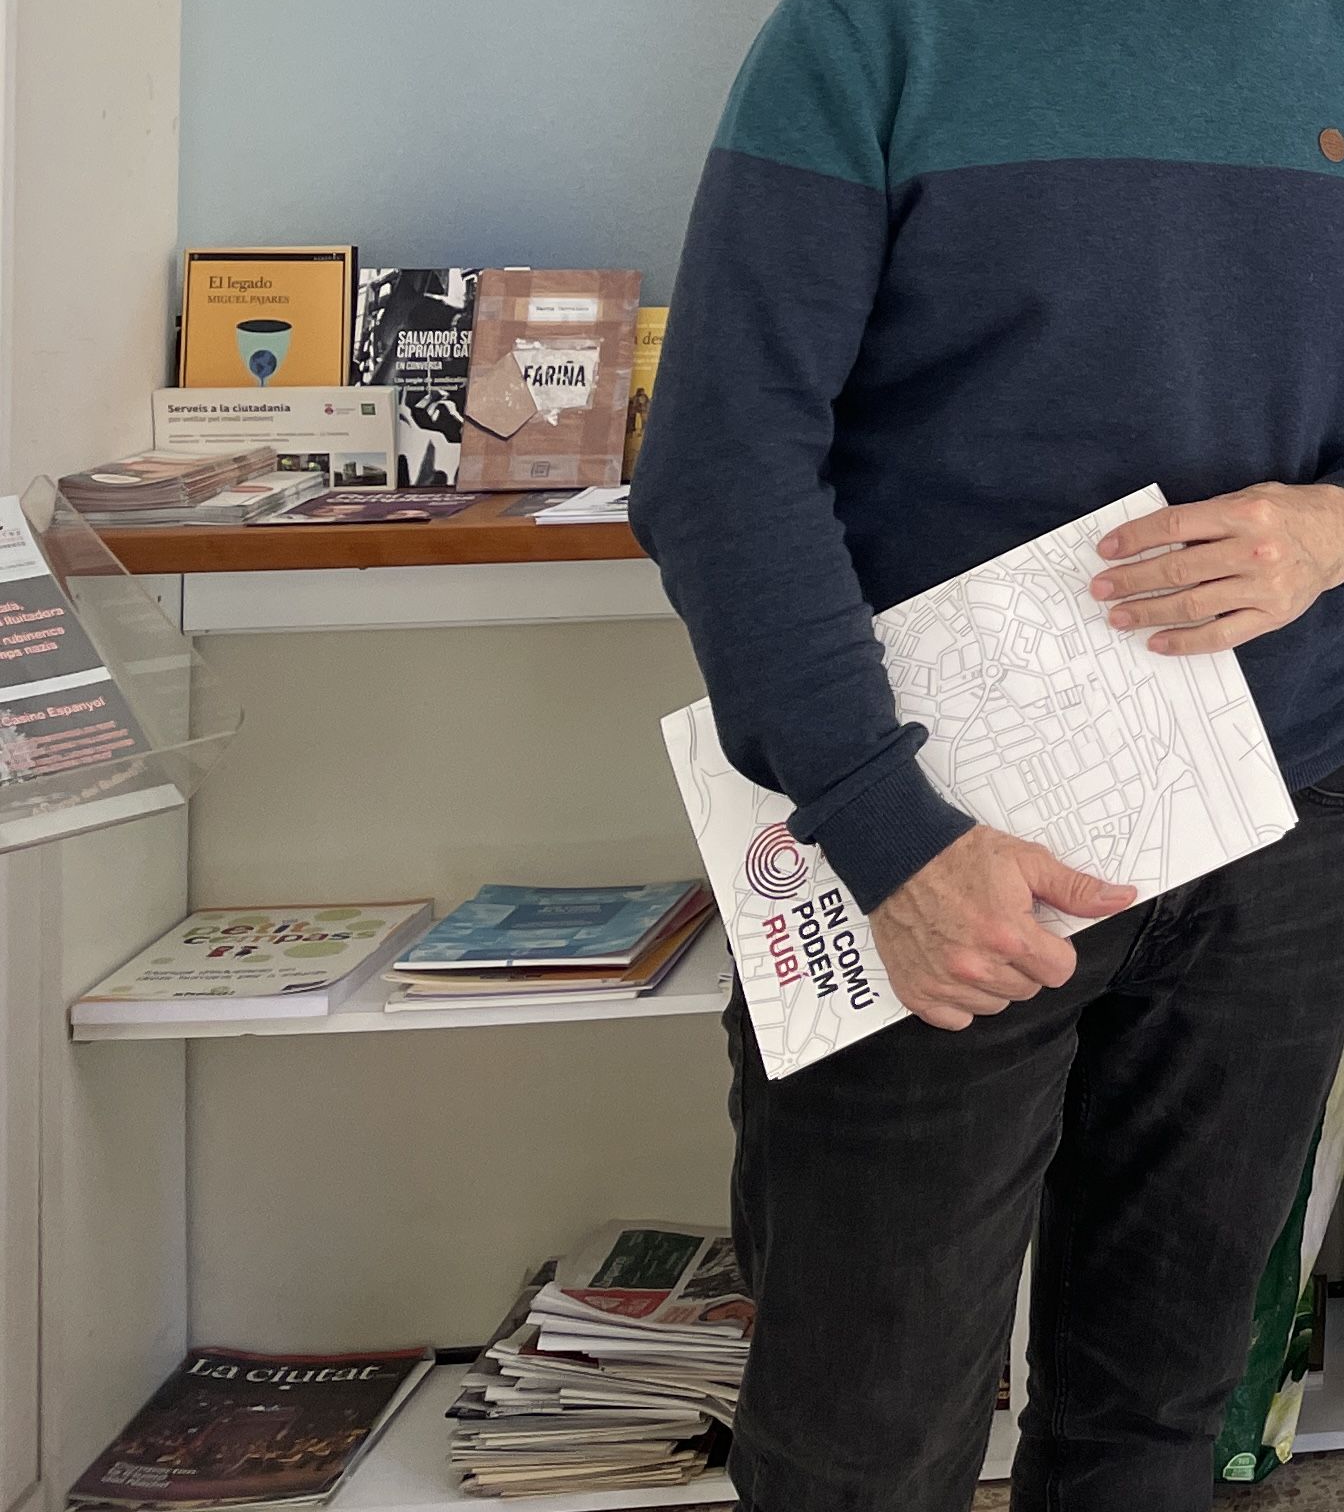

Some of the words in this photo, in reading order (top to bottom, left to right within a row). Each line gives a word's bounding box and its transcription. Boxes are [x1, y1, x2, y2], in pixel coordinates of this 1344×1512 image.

[208, 275, 223, 290] El
[227, 275, 273, 293] legado
[207, 295, 248, 304] MIGUEL
[249, 295, 290, 305] PAJARES
[396, 343, 451, 358] CIPRIANO
[453, 343, 471, 358] GA
[397, 330, 458, 345] SALVADOR
[523, 360, 587, 387] FARIÑA
[167, 403, 208, 414] Serveis
[209, 405, 217, 413] a
[219, 403, 230, 413] la
[232, 403, 292, 413] ciutadania
[1, 711, 46, 727] Casino
[46, 696, 106, 718] Espanyol
[818, 888, 849, 930] EN
[761, 913, 812, 988] RUBÍ
[791, 900, 840, 999] PODEM
[831, 928, 882, 1012] COMÚ
[187, 1358, 241, 1380] La
[245, 1364, 383, 1385] ciutat
